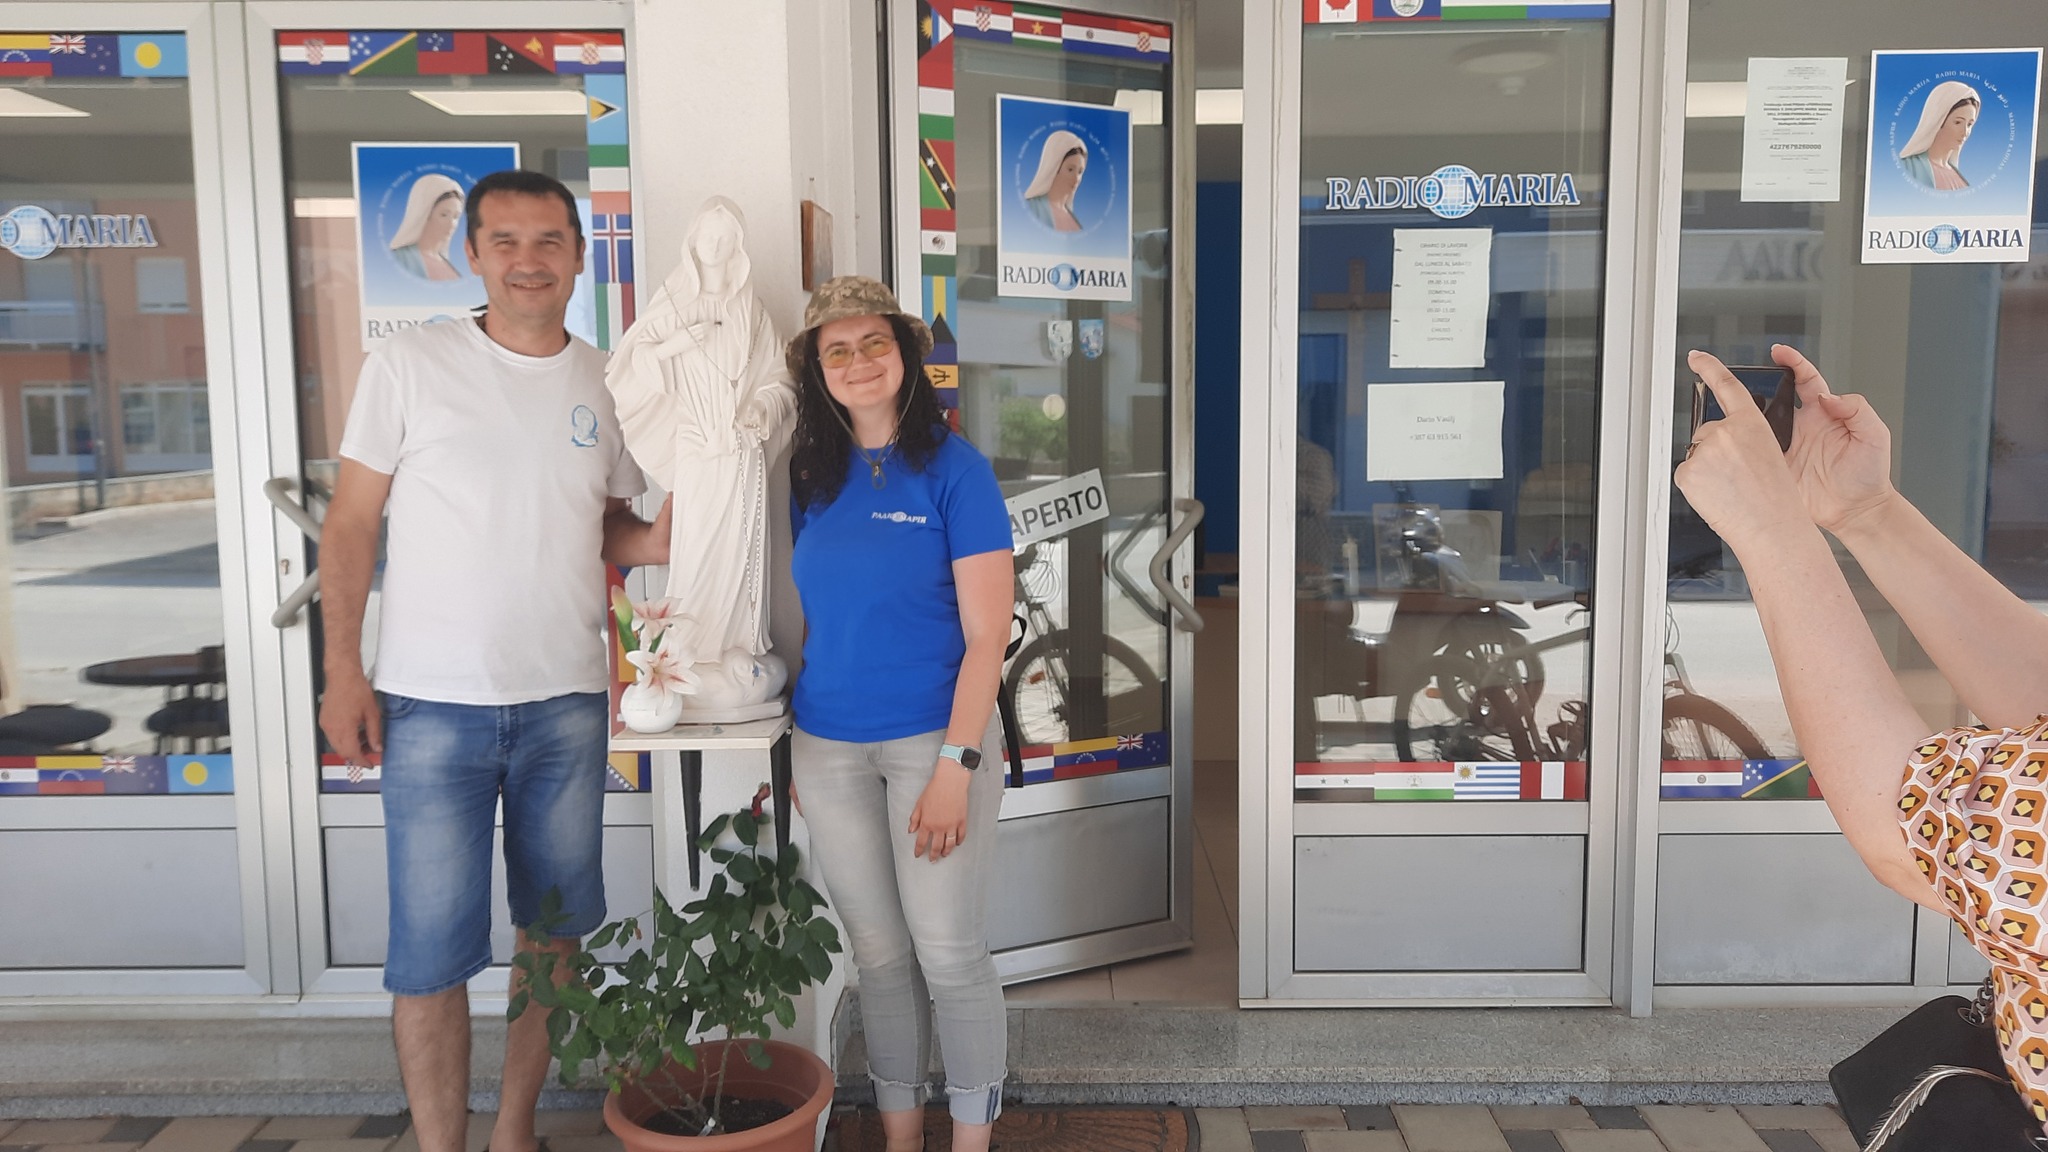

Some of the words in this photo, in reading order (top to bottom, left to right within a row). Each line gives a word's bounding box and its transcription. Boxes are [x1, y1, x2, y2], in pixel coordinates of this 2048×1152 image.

[1935, 70, 1957, 79] RADIO
[1959, 70, 1980, 81] MARIA
[1326, 176, 1443, 210] RADIO
[1462, 173, 1580, 206] MARIA
[40, 214, 158, 248] MARIA
[1868, 229, 1938, 249] RADIO
[1951, 229, 2024, 248] MARIA
[1003, 265, 1061, 285] RADIO
[1069, 268, 1127, 288] MARIA
[1010, 486, 1102, 536] APERTO
